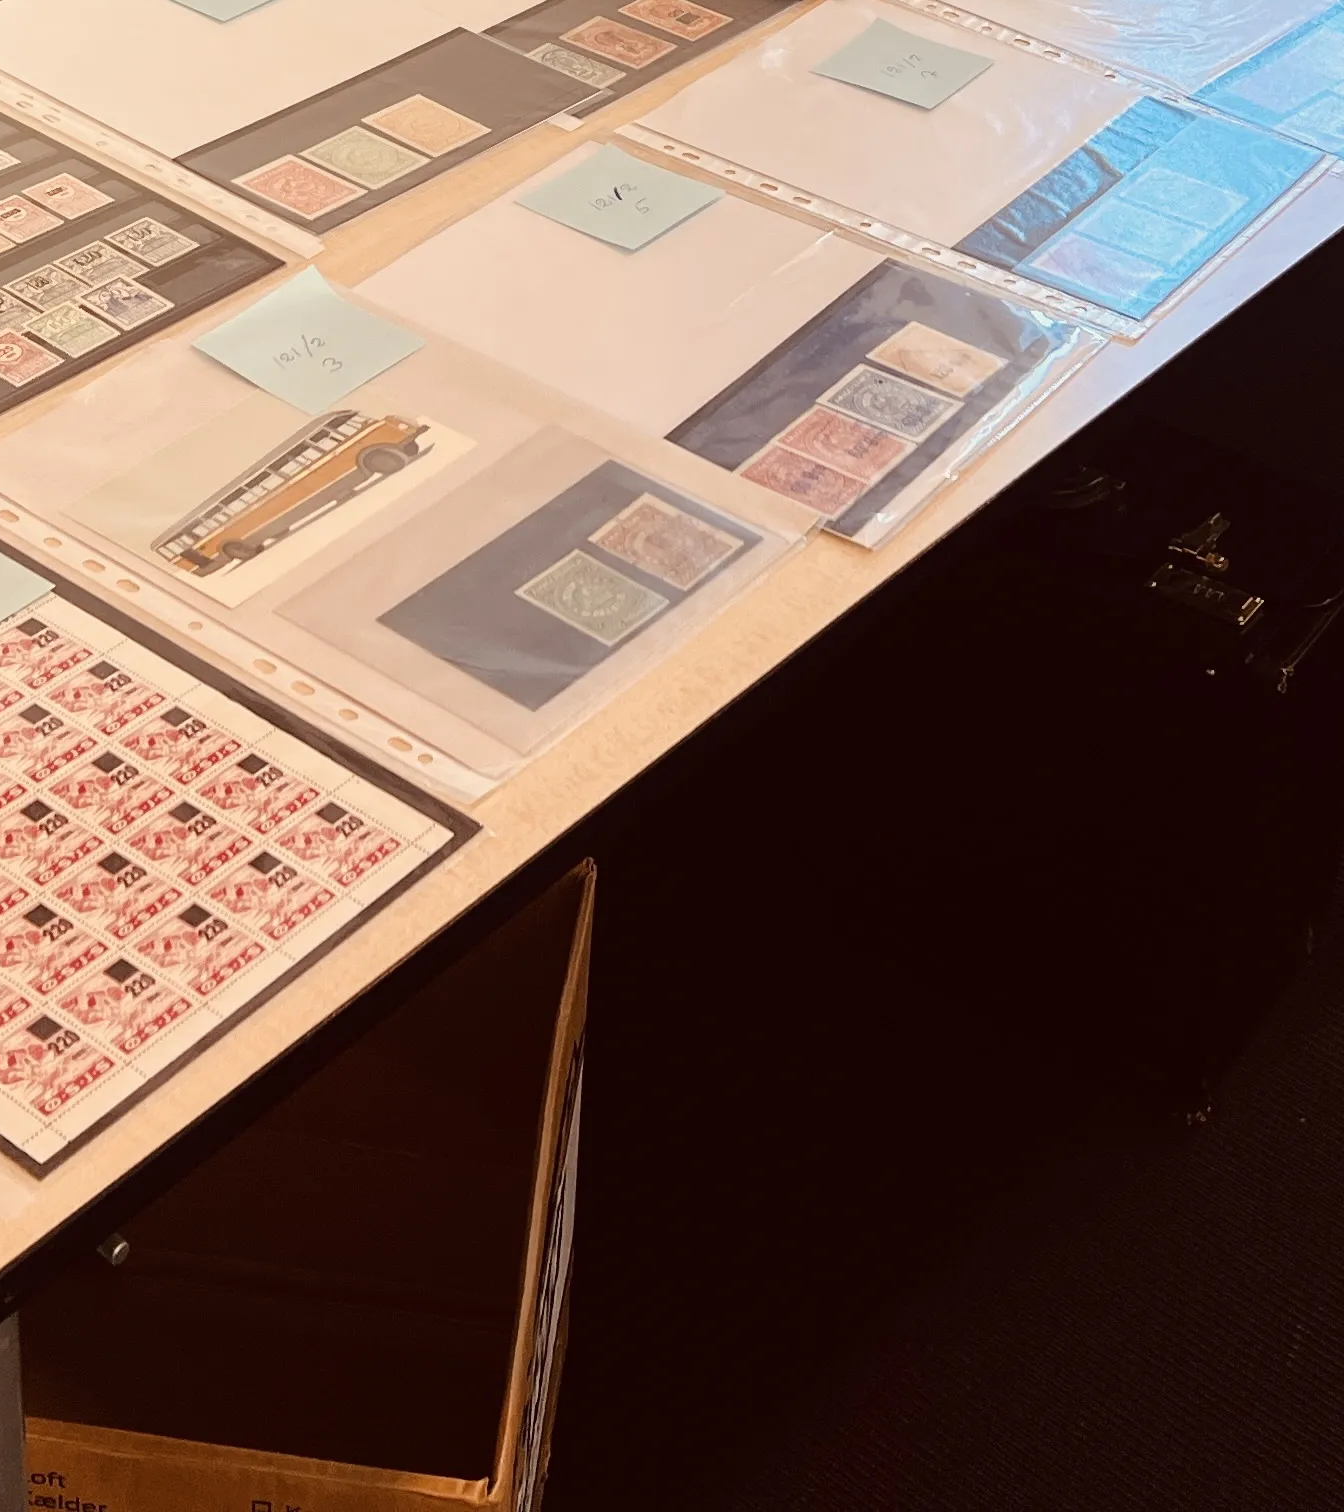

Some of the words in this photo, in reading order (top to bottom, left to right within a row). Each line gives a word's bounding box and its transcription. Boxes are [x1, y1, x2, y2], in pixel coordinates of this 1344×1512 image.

[272, 334, 326, 371] 121/2
[322, 357, 344, 374] 3
[33, 630, 59, 648] 220
[105, 673, 132, 692] 220
[36, 716, 64, 737] 220
[179, 719, 206, 739] 220
[111, 764, 139, 786] 220
[256, 766, 283, 787] 220
[39, 813, 68, 835] 220
[188, 814, 217, 837] 220
[336, 816, 363, 838] 220
[117, 865, 147, 888] 220
[270, 866, 297, 888] 220
[44, 917, 74, 942] 220
[199, 918, 228, 942] 220
[125, 973, 155, 998] 220
[48, 1030, 79, 1056] 220
[27, 1472, 66, 1489] oft
